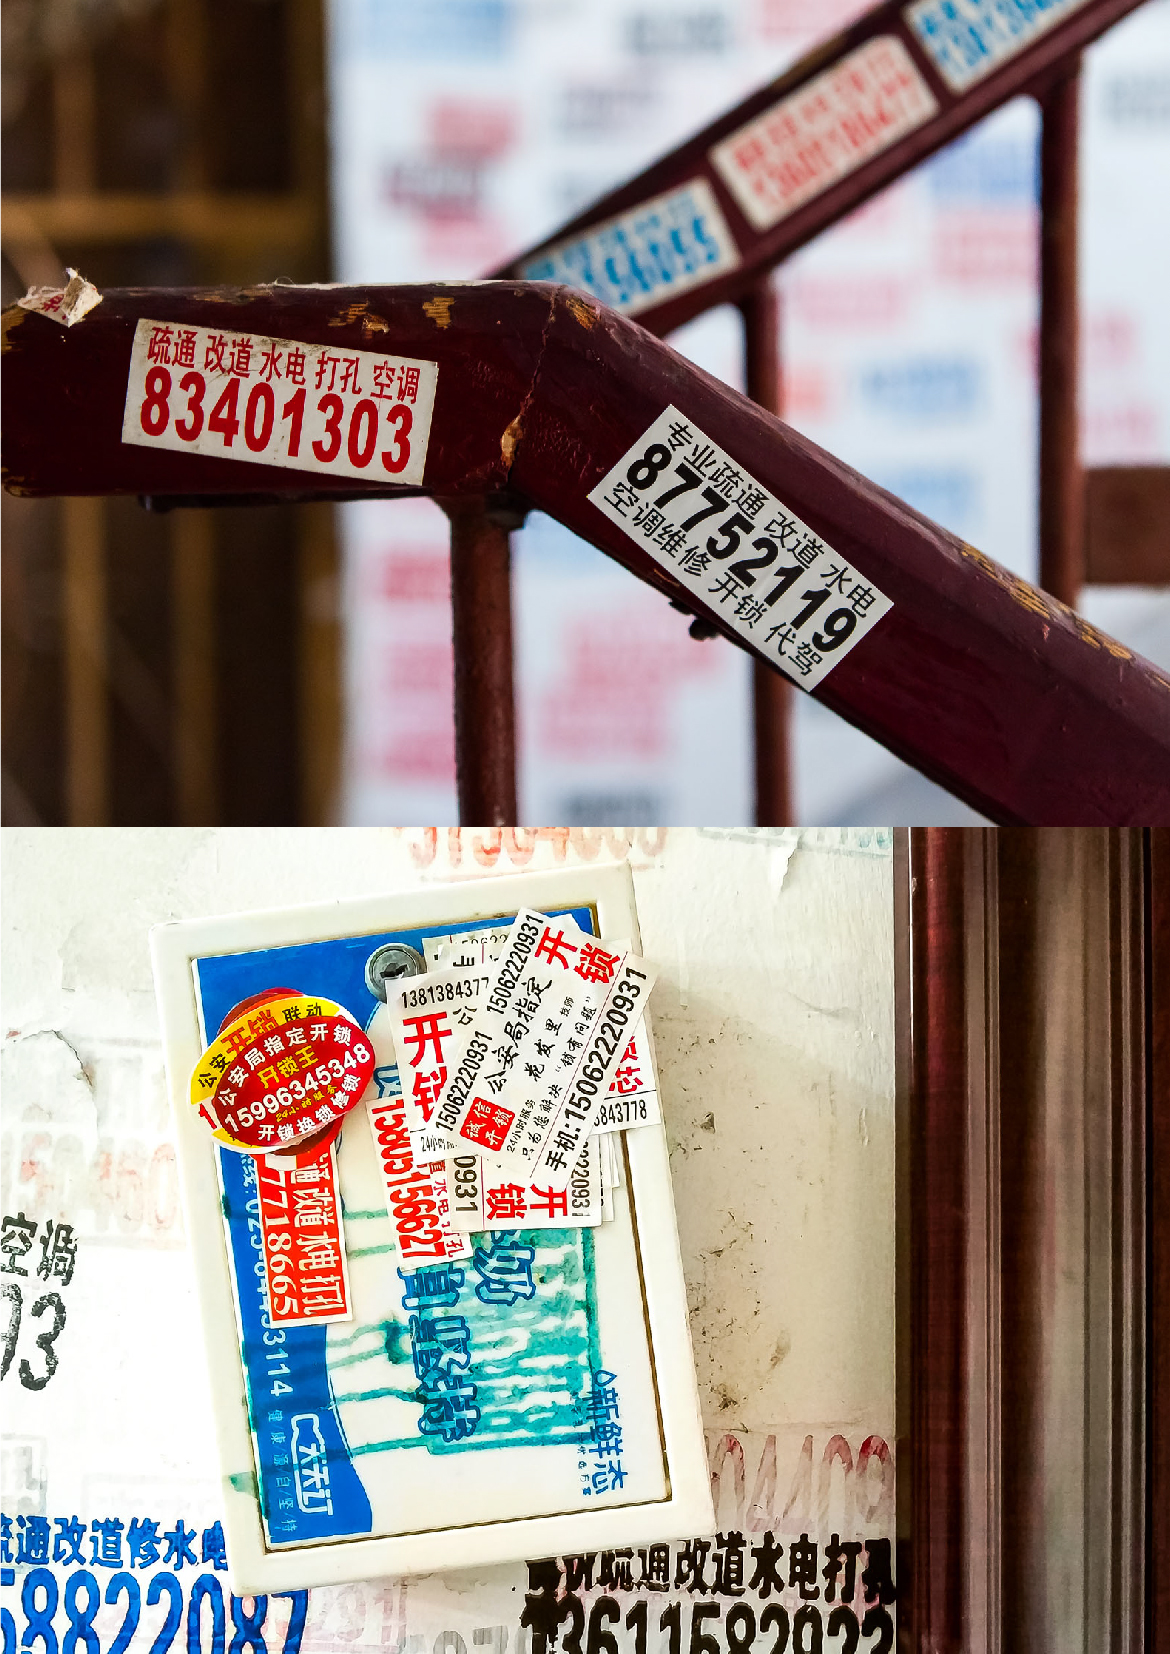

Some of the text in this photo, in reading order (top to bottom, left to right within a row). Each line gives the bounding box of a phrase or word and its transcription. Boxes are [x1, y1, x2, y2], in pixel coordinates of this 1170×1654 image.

[148, 326, 421, 405] 疏通 改道 水电 打孔 空调
[140, 366, 413, 473] 83401303
[626, 443, 857, 652] 87752119
[668, 422, 876, 618] 专业疏通 改道 水电
[604, 482, 823, 676] 空调维修 开锁 代驾
[487, 914, 544, 1015] 15062220931
[535, 926, 621, 984] 开锁
[219, 1023, 352, 1108] 公安局指定开锁
[436, 1030, 493, 1131] 15062220931
[484, 976, 552, 1094] 公安局指定
[224, 1043, 370, 1133] 15996345348
[261, 1170, 299, 1316] 7718665
[296, 1231, 340, 1271] 水电
[486, 1182, 567, 1220] 开锁
[300, 1275, 345, 1316] 打孔
